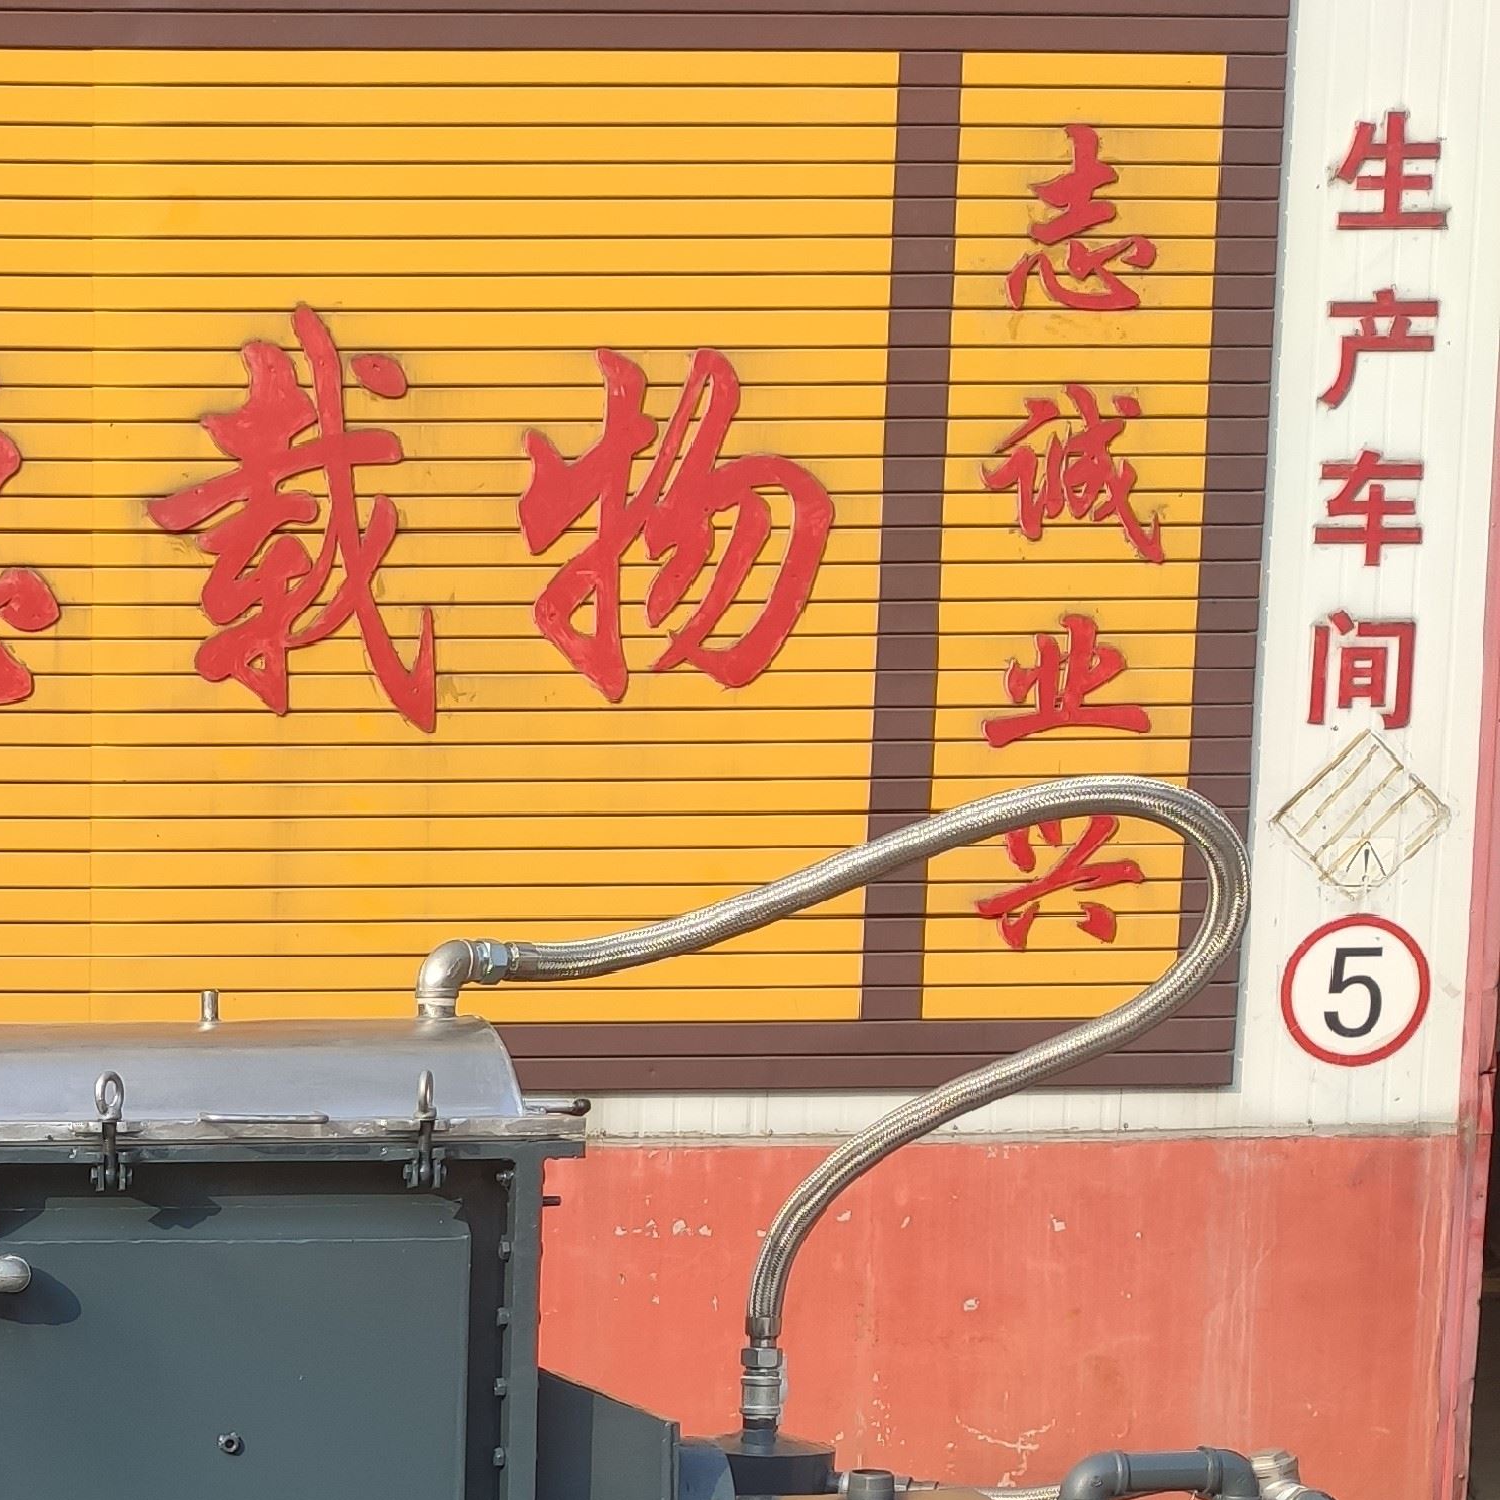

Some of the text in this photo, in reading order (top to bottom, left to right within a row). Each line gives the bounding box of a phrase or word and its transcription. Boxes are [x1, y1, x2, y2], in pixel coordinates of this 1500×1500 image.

[977, 124, 1164, 950] 志诚业兴
[1309, 112, 1446, 731] 生产车间
[1322, 946, 1385, 1039] 5
